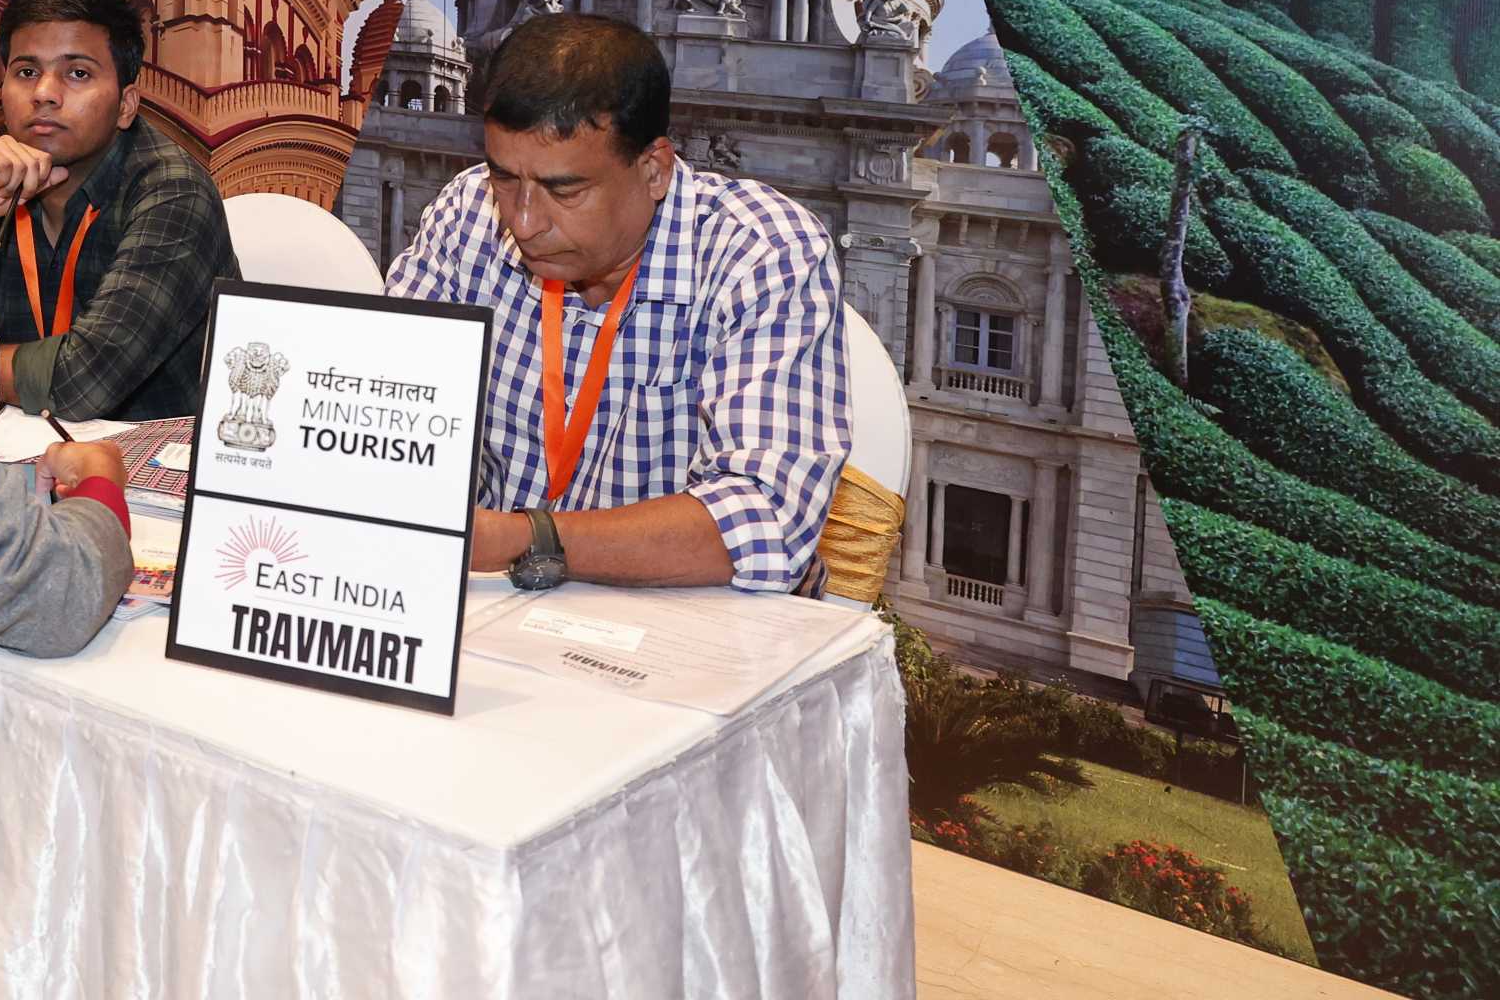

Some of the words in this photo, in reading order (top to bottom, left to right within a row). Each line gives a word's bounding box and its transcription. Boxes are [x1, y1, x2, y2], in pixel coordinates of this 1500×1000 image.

[307, 367, 363, 395] पर्यटन
[369, 375, 438, 403] मंत्रालय
[302, 398, 421, 433] MINISTRY
[428, 415, 462, 438] OF
[300, 425, 435, 466] TOURISM
[256, 562, 323, 597] EAST
[334, 576, 406, 613] INDIA
[232, 604, 422, 684] TRAVMART
